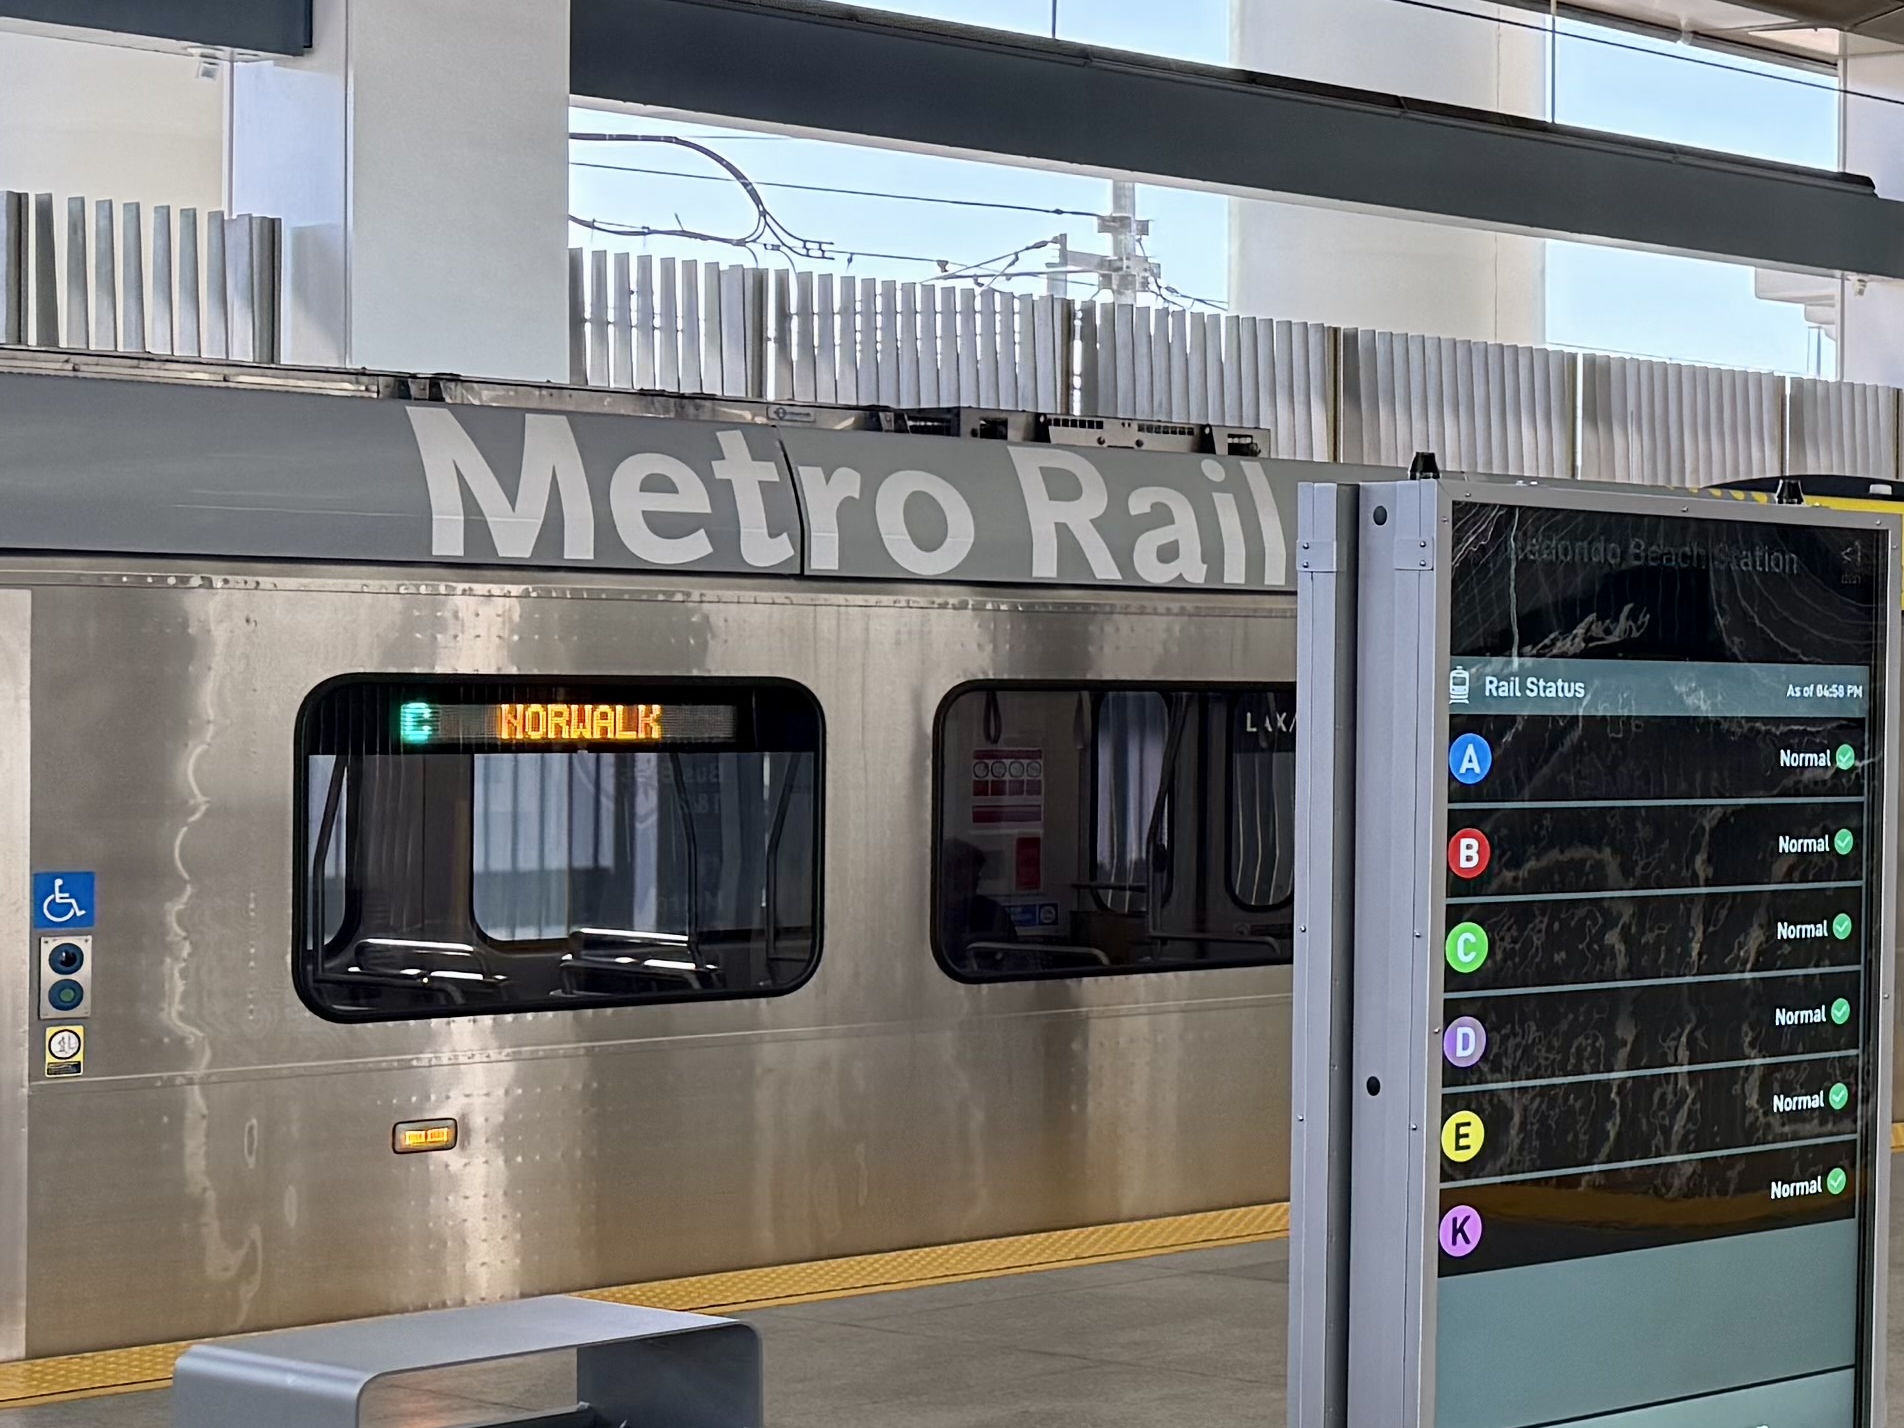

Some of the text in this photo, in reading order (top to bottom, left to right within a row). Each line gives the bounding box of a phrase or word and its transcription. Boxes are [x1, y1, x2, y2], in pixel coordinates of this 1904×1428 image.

[405, 406, 1288, 586] Metro Rail
[1484, 675, 1586, 699] Rail Status
[1786, 683, 1801, 698] As
[1803, 683, 1814, 698] of
[1848, 685, 1863, 699] PM
[401, 702, 662, 741] C NORWALK
[1459, 743, 1831, 775] A Normal
[1459, 833, 1830, 869] B Normal
[1457, 919, 1828, 963] C Normal
[1456, 1005, 1827, 1058] D Normal
[1453, 1089, 1825, 1152] E Normal
[1450, 1176, 1822, 1247] K Normal
